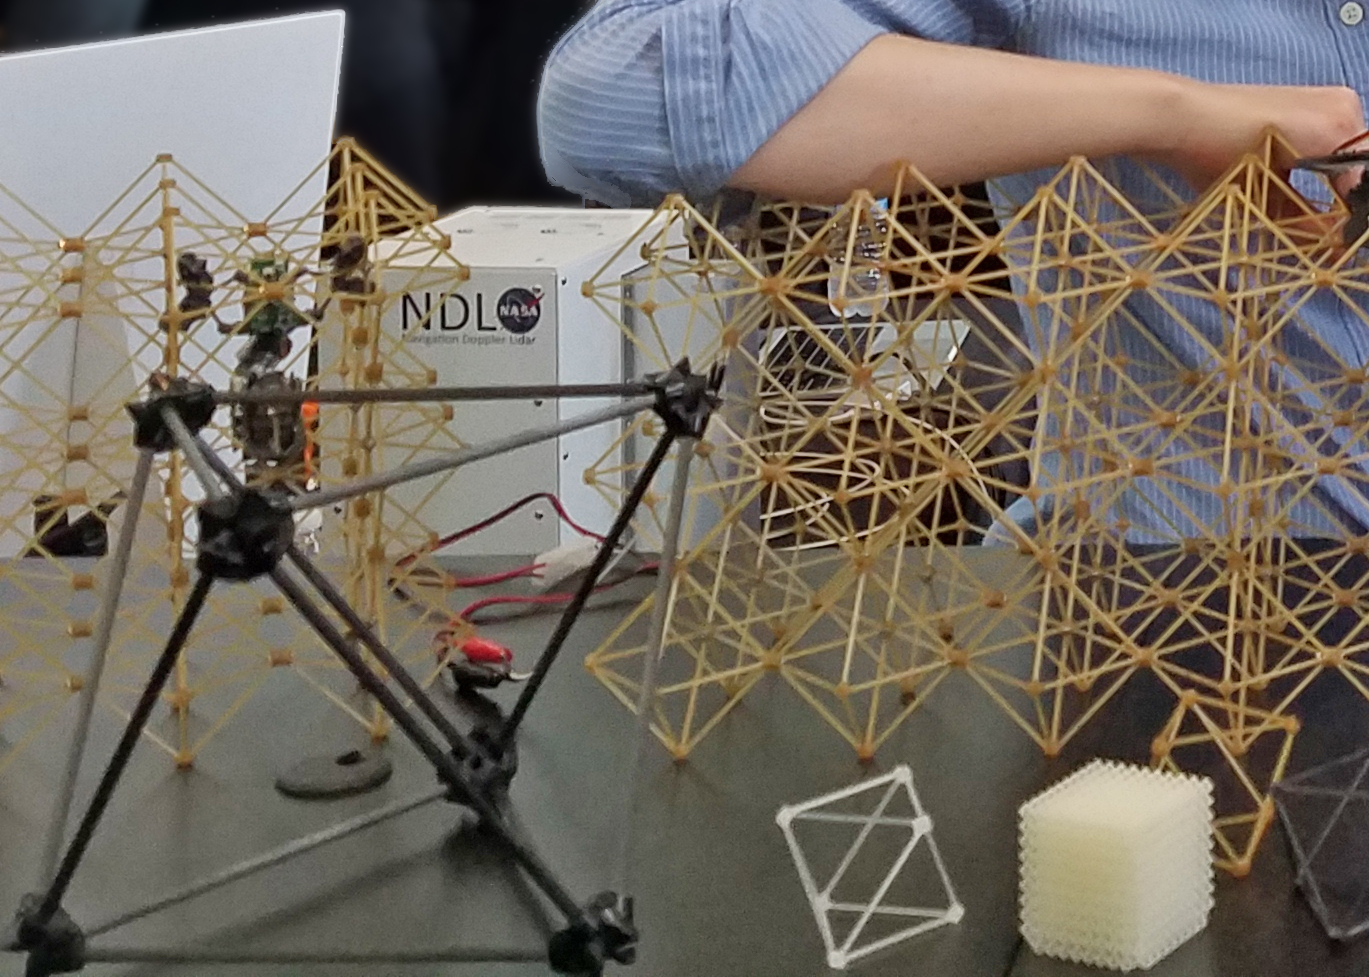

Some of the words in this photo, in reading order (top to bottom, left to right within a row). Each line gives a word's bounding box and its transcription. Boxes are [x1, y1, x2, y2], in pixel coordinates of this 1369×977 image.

[402, 292, 497, 331] NDL
[499, 305, 538, 318] NASA
[462, 334, 505, 346] Doppler
[509, 334, 537, 346] Lidar
